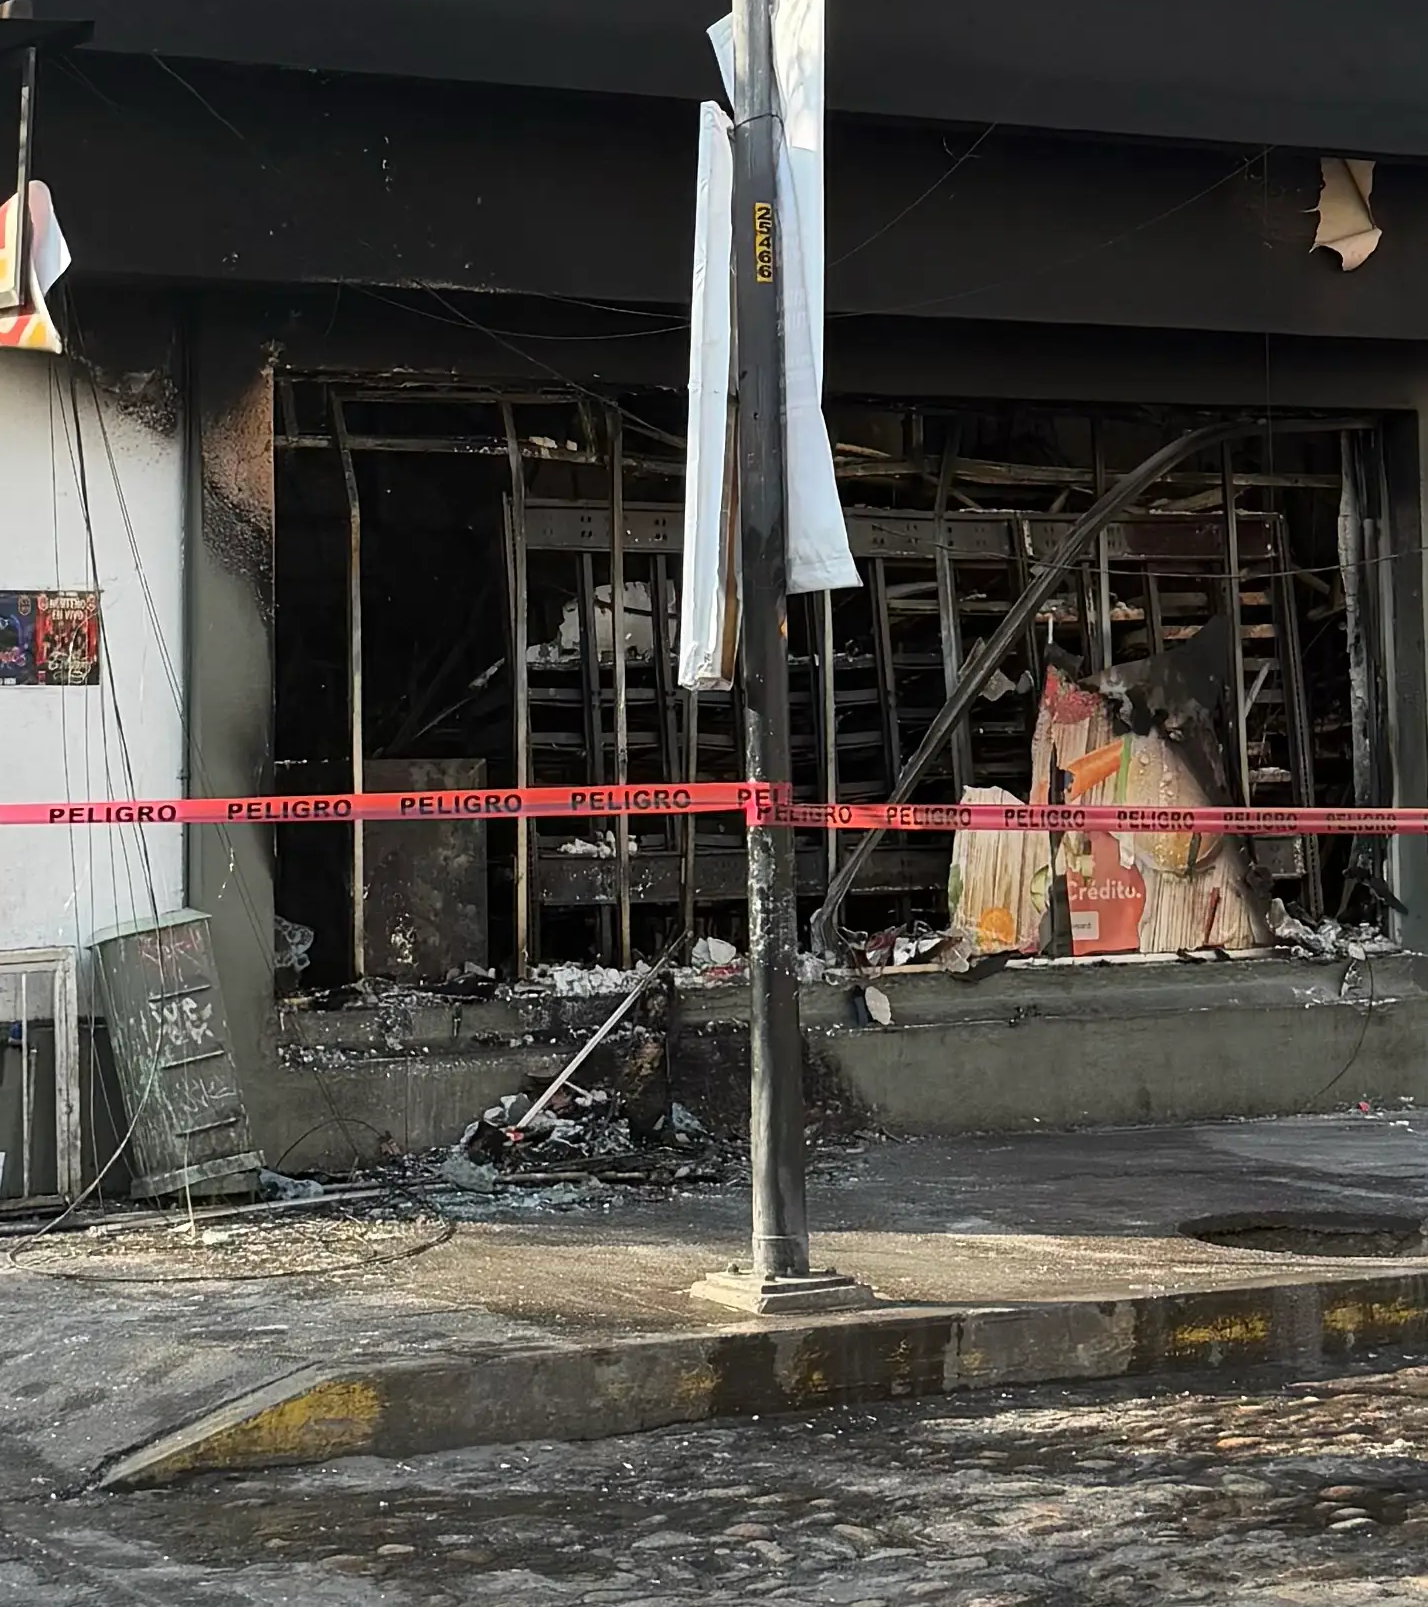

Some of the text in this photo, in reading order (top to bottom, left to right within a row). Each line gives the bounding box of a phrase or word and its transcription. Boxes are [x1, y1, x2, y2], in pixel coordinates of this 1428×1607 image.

[756, 205, 773, 279] 25466
[49, 805, 177, 824] PELIGRO
[227, 799, 352, 821] PELIGRO
[400, 794, 523, 816] PELIGRO
[571, 789, 691, 812] PELIGRO
[886, 806, 972, 827] PELIGRO
[1004, 809, 1086, 828] PELIGRO
[1116, 810, 1195, 830] PELIGRO
